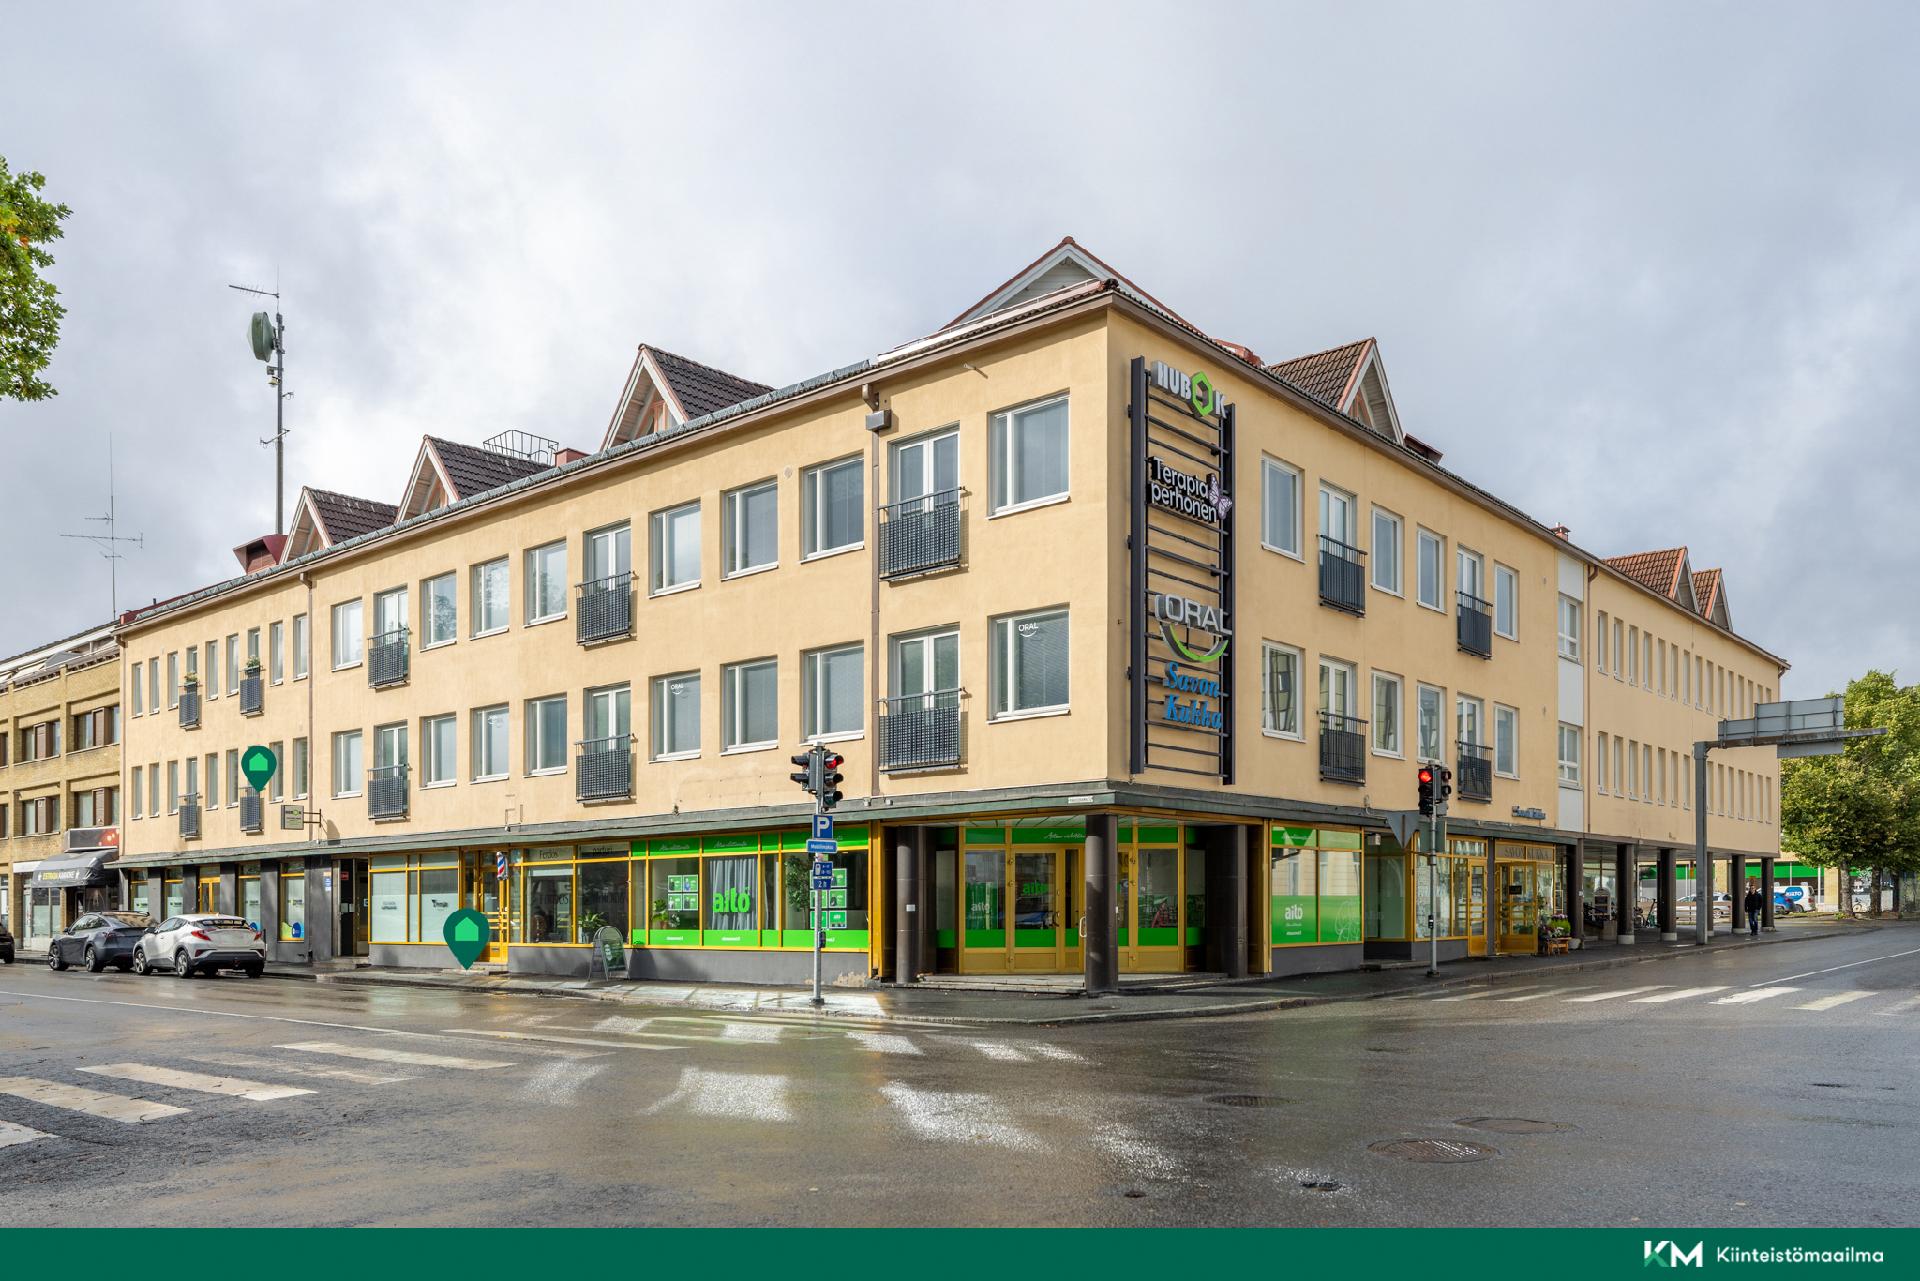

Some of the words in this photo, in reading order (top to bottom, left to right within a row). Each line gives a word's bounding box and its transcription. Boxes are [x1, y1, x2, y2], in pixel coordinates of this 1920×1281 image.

[1153, 456, 1209, 498] Terapia
[1151, 482, 1217, 522] perhonen
[1018, 622, 1039, 632] ORAL
[1162, 594, 1232, 634] ORAL
[1166, 661, 1220, 698] Savon
[1166, 694, 1222, 729] Kukka
[816, 816, 830, 837] P
[712, 887, 751, 913] aito
[1284, 904, 1304, 920] aito
